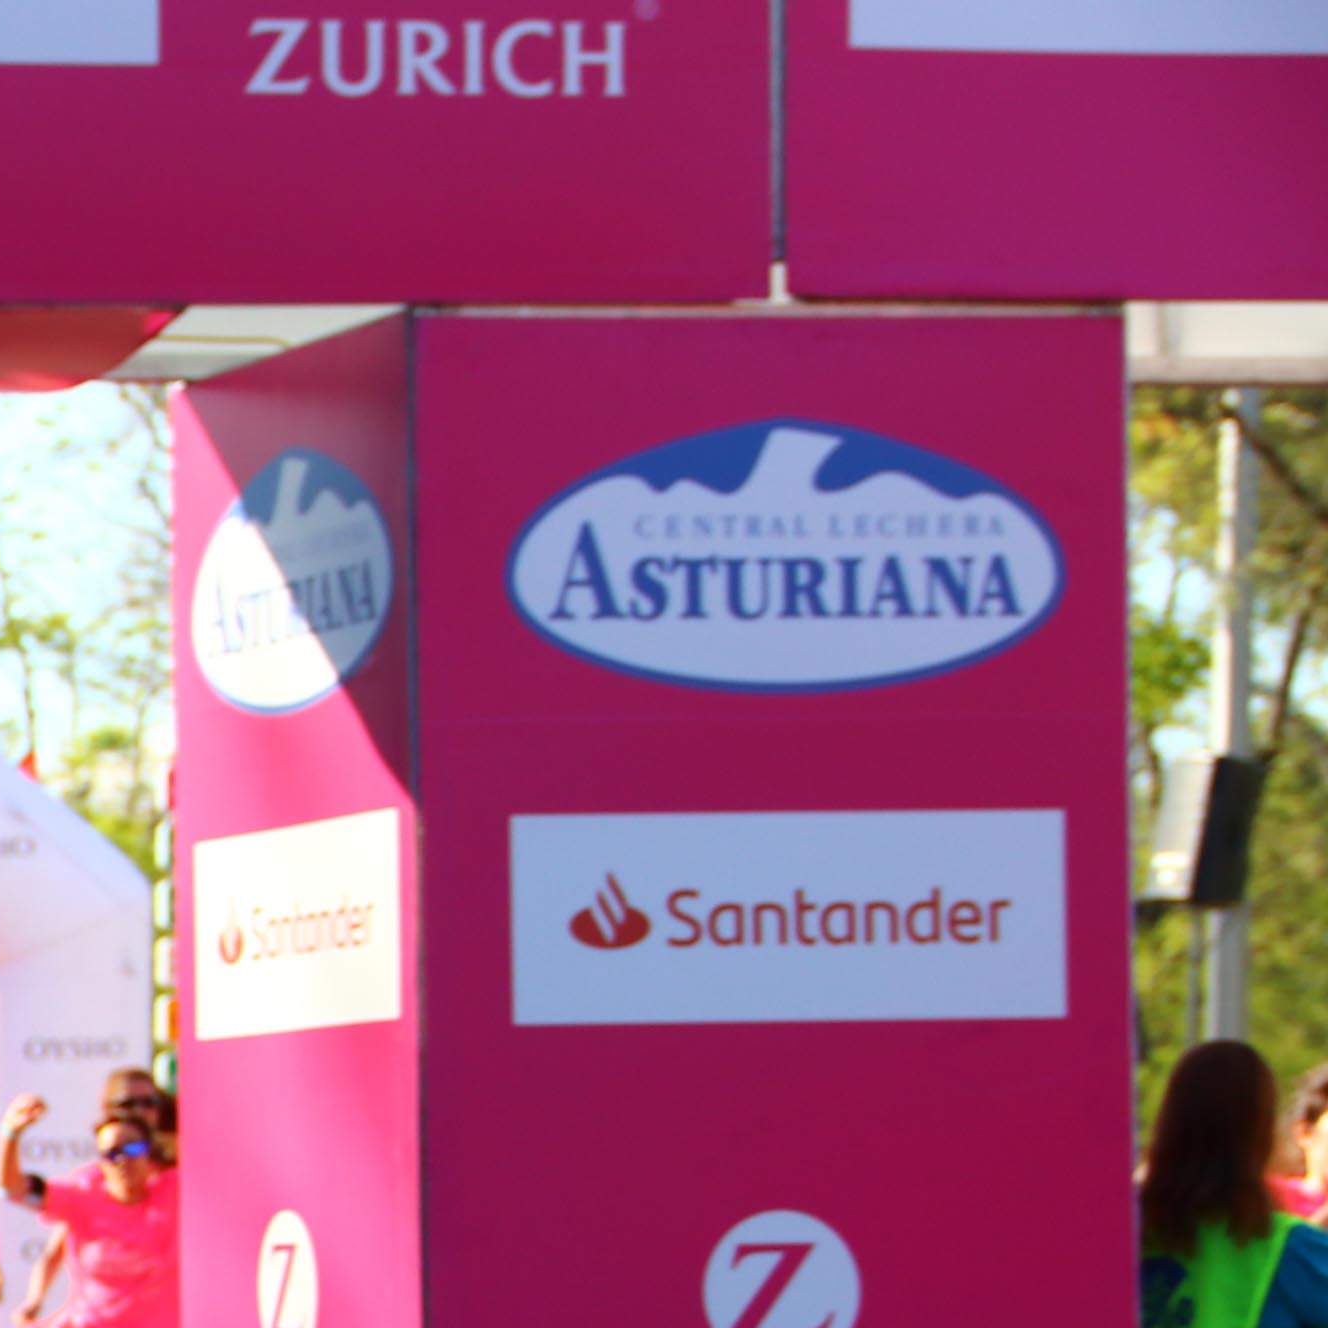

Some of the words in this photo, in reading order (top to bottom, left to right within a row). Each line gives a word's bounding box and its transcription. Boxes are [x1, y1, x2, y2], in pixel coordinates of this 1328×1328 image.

[245, 18, 627, 98] ZURICH
[634, 512, 809, 538] CENTRAL
[828, 511, 1006, 538] LECHERA
[548, 519, 1024, 622] ASTURIANA
[249, 900, 375, 961] Santander
[665, 886, 1012, 948] Santander
